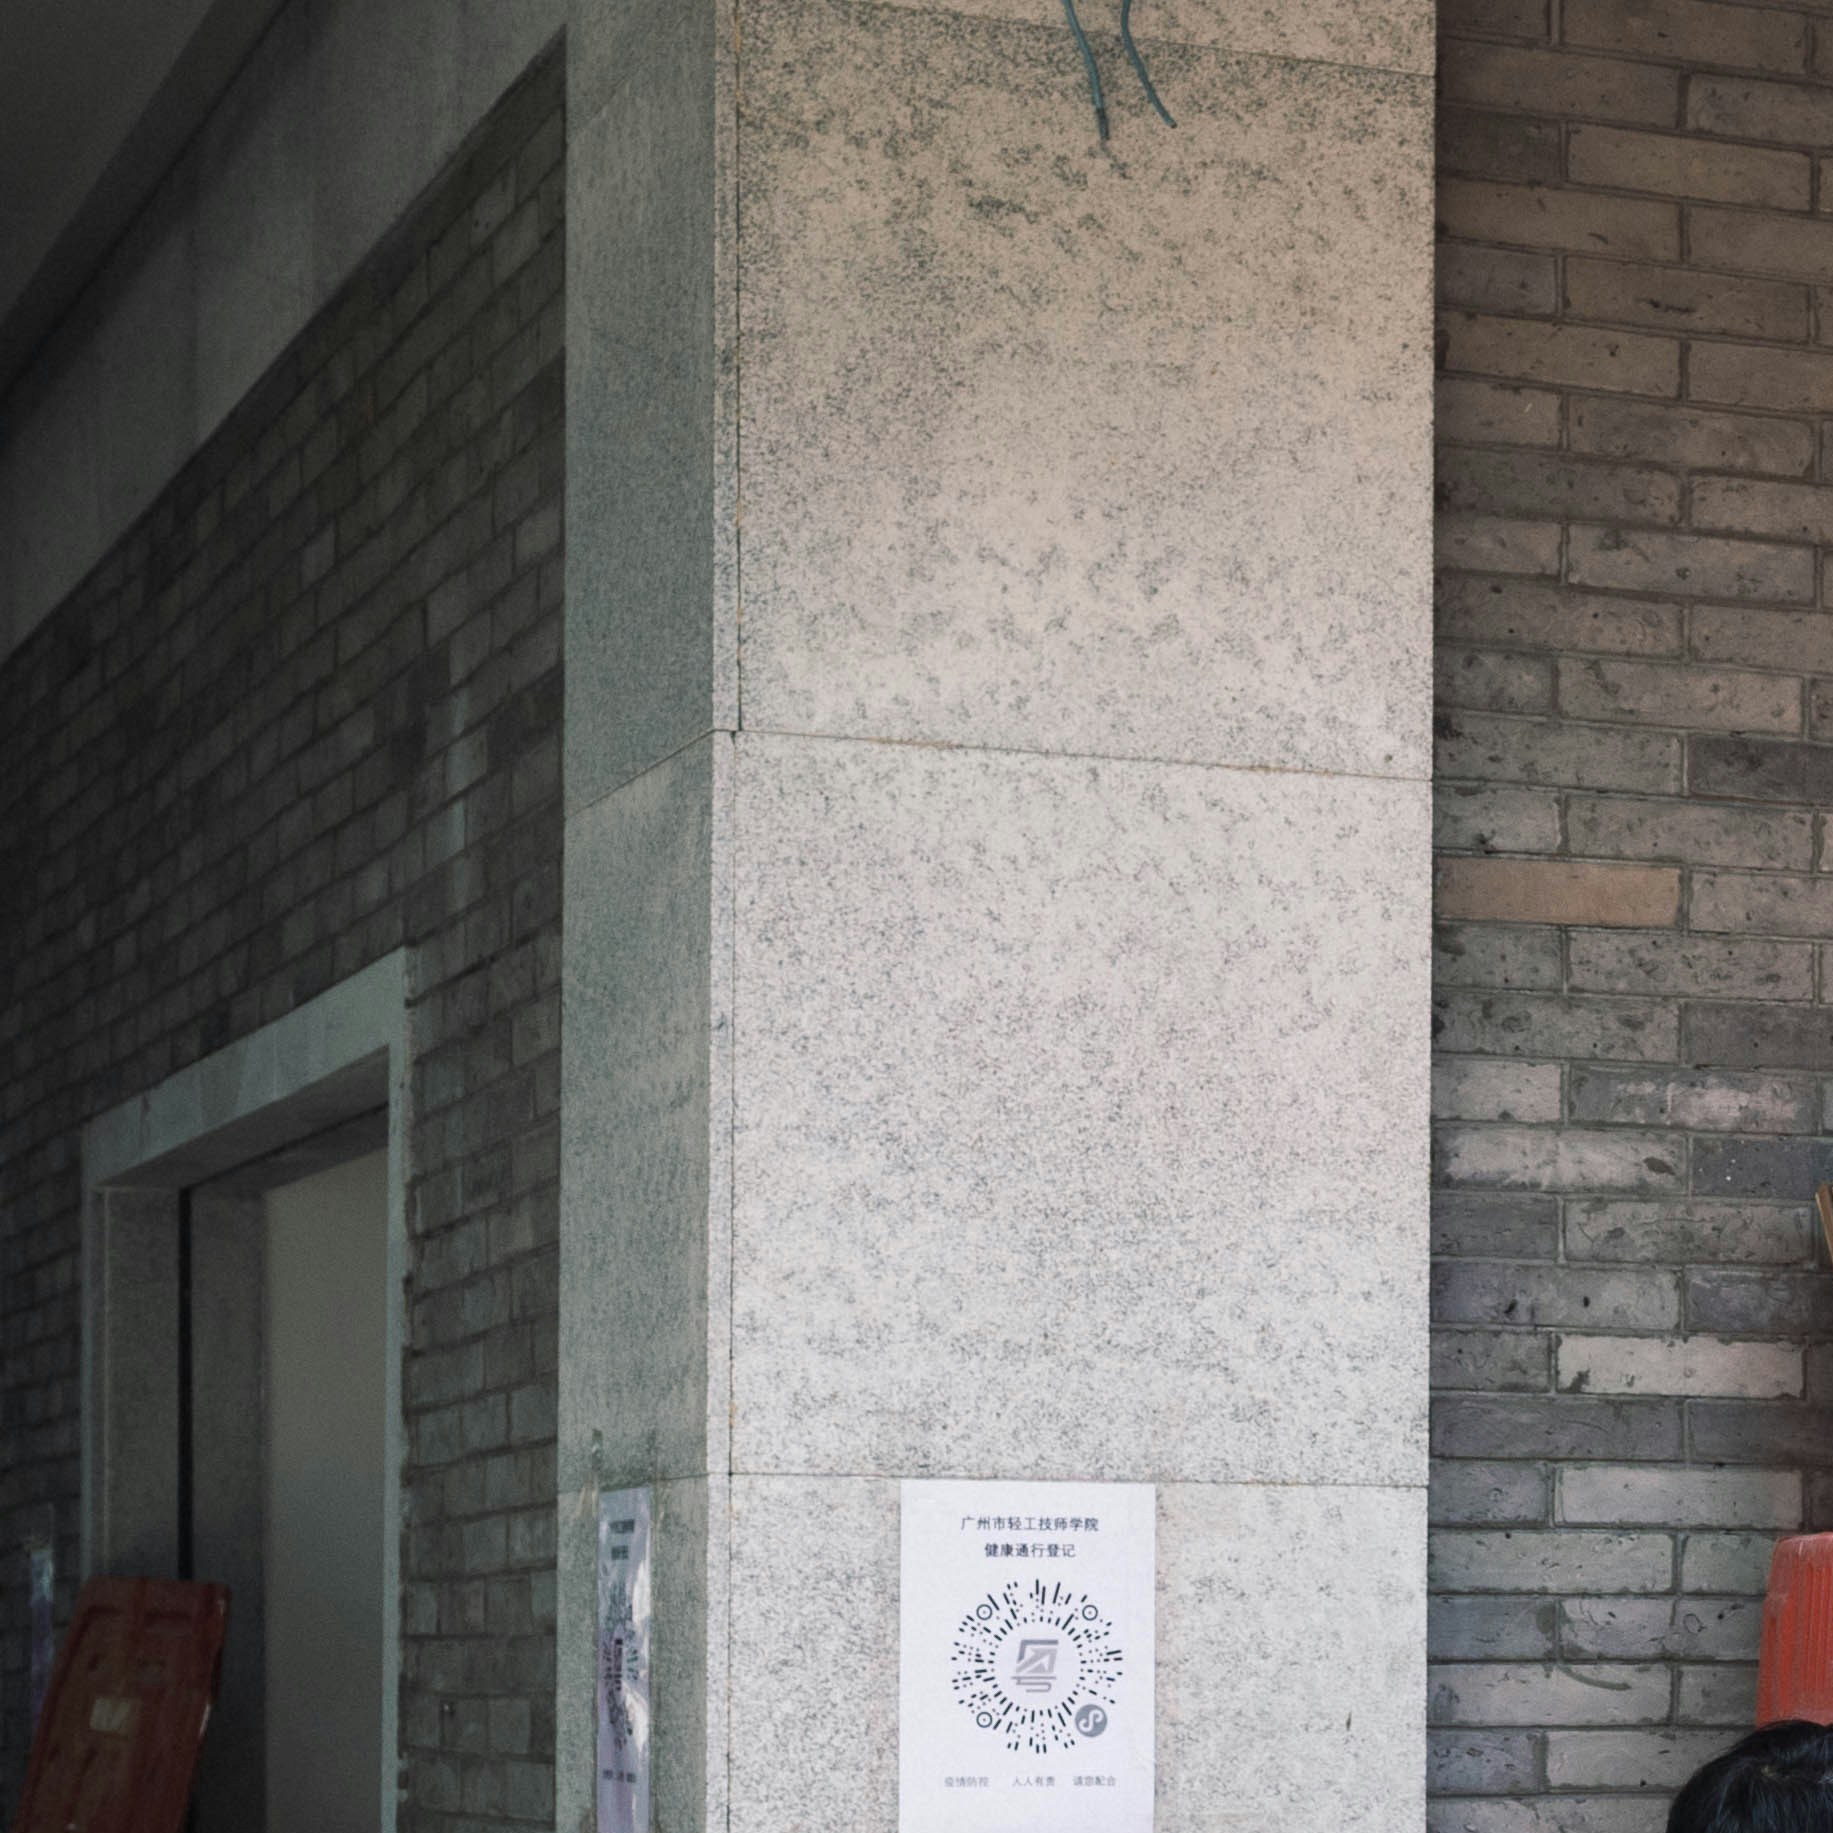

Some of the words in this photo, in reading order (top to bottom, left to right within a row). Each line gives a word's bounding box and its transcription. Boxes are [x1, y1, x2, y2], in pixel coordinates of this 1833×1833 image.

[960, 1515, 1099, 1532] 广州市轻工技师学院
[983, 1542, 1076, 1558] 健康通行登记
